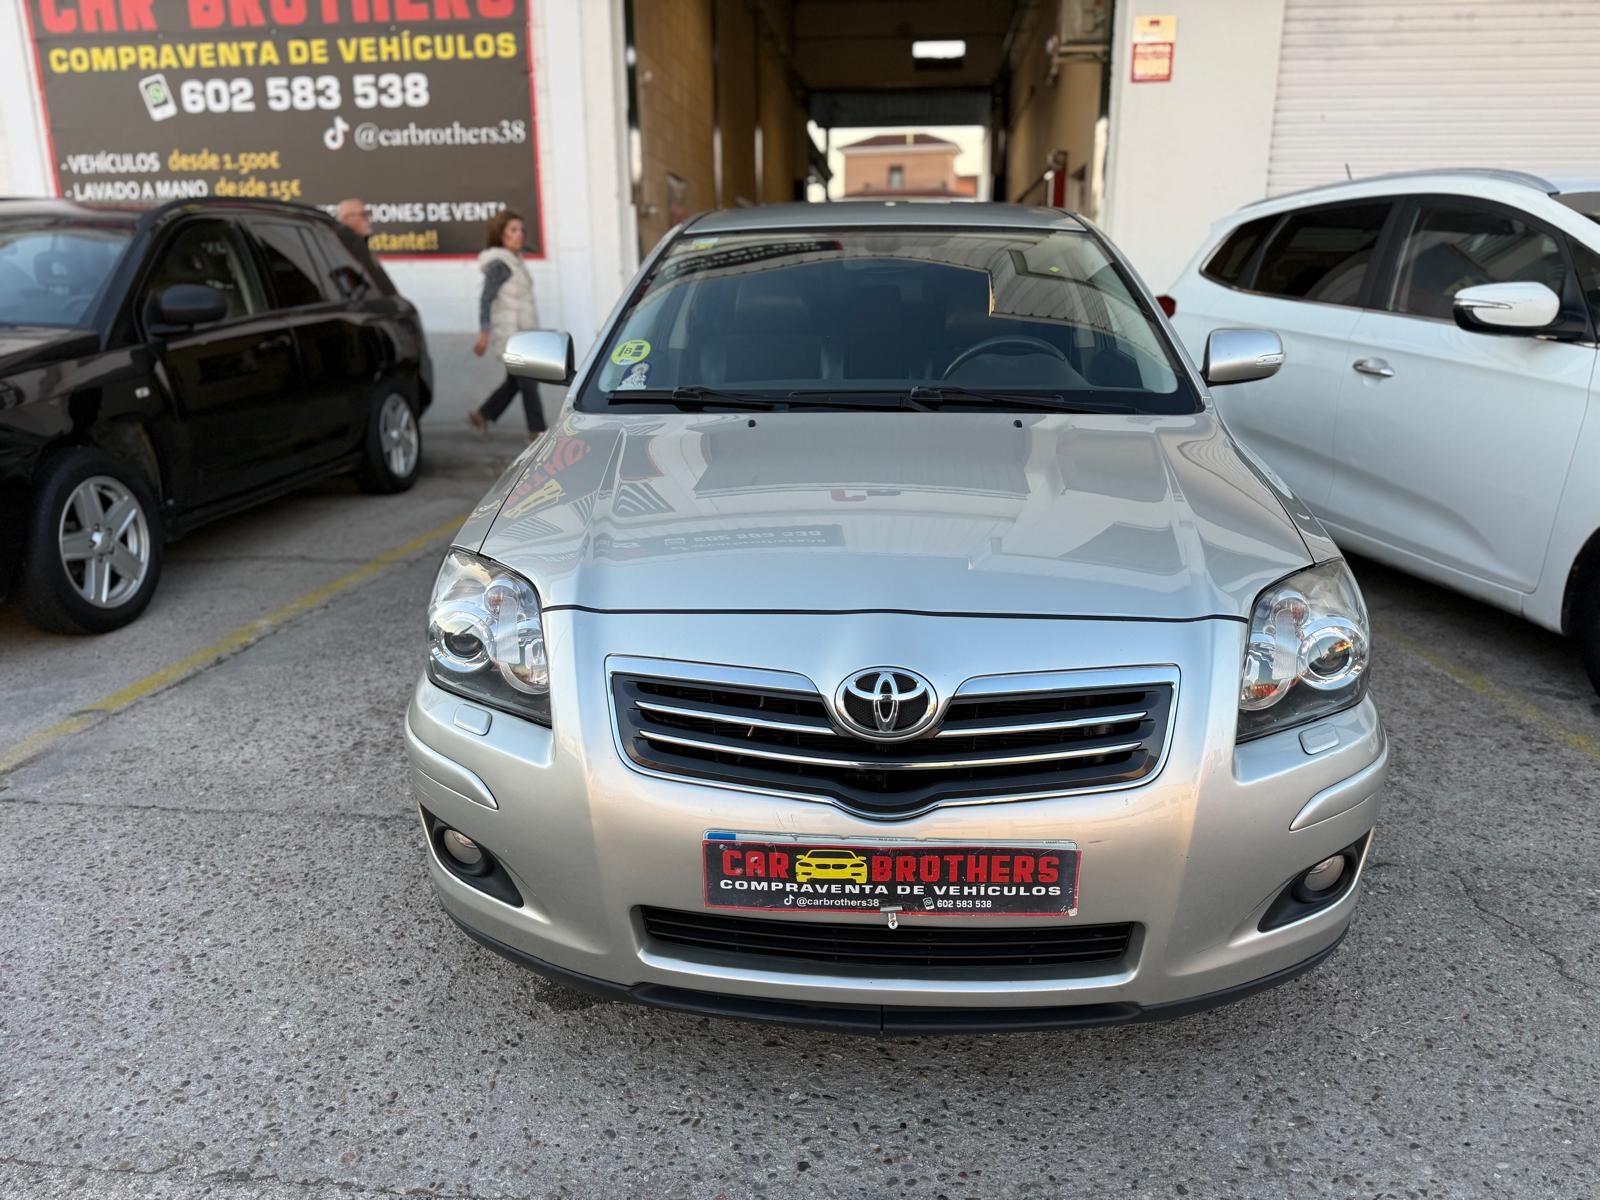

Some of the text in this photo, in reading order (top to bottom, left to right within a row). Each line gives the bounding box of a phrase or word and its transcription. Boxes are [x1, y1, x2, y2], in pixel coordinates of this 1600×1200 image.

[49, 30, 517, 73] COMPRAVENTA DE VEHÍCULOS
[180, 72, 430, 114] 602 583 538
[354, 119, 526, 150] @carbrothers38
[168, 148, 220, 172] desde
[223, 150, 281, 174] 1.500€
[73, 176, 302, 202] LAVADO A MANO desde 15€
[426, 202, 451, 222] DE
[721, 850, 1060, 884] CAR BROTHERS
[720, 879, 1062, 896] COMPRAVENTA DE VEHÍCULOS
[796, 896, 880, 907] @carbrothers38
[937, 900, 992, 909] 602 583 538
